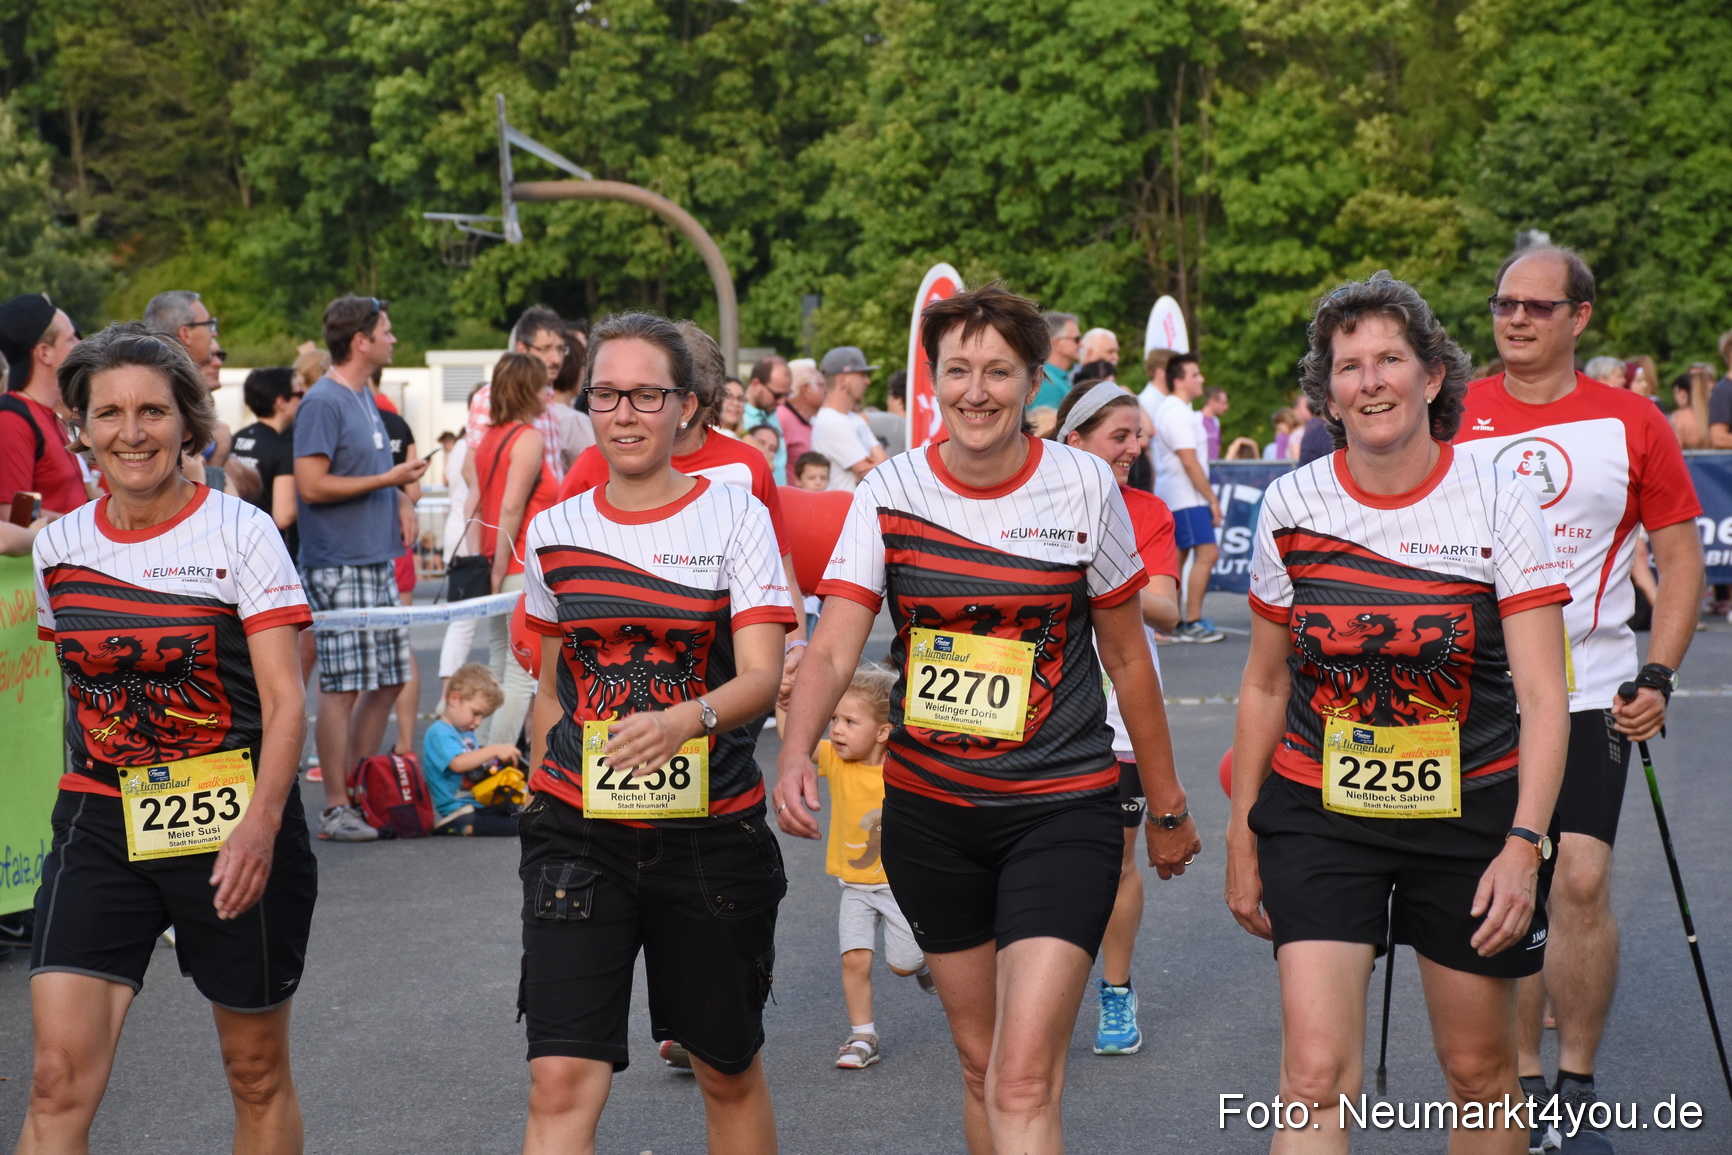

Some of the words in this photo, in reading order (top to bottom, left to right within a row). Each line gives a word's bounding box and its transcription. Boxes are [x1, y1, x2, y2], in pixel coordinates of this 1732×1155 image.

[1000, 527, 1075, 542] NEUMARKT
[1400, 541, 1478, 557] NEUMARKT
[653, 553, 725, 566] NEUMARKT
[1560, 559, 1575, 569] tik
[142, 565, 214, 578] NEUMARKT
[925, 648, 971, 663] firmenlauf
[974, 661, 999, 673] walk
[998, 665, 1024, 676] 2019
[918, 665, 1010, 709] 2270
[925, 702, 969, 716] Weidinger
[971, 708, 998, 720] Doris
[934, 713, 951, 721] Stadt
[950, 716, 983, 726] Neumarkt
[1343, 739, 1395, 754] firmenlauf
[1401, 747, 1426, 759] walk
[1426, 748, 1451, 758] 2019
[392, 755, 409, 787] BAYER
[1338, 756, 1442, 793] 2256
[140, 776, 191, 792] firmenlauf
[197, 776, 221, 790] walk
[222, 775, 246, 786] 2019
[611, 792, 646, 801] Reichel
[649, 792, 677, 803] Tanja
[1346, 791, 1397, 802] Nießlbeck
[1400, 794, 1436, 802] Sabine
[139, 787, 241, 832] 2253
[167, 829, 195, 840] Meier
[197, 825, 221, 836] Susi
[187, 835, 222, 845] Neumarkt
